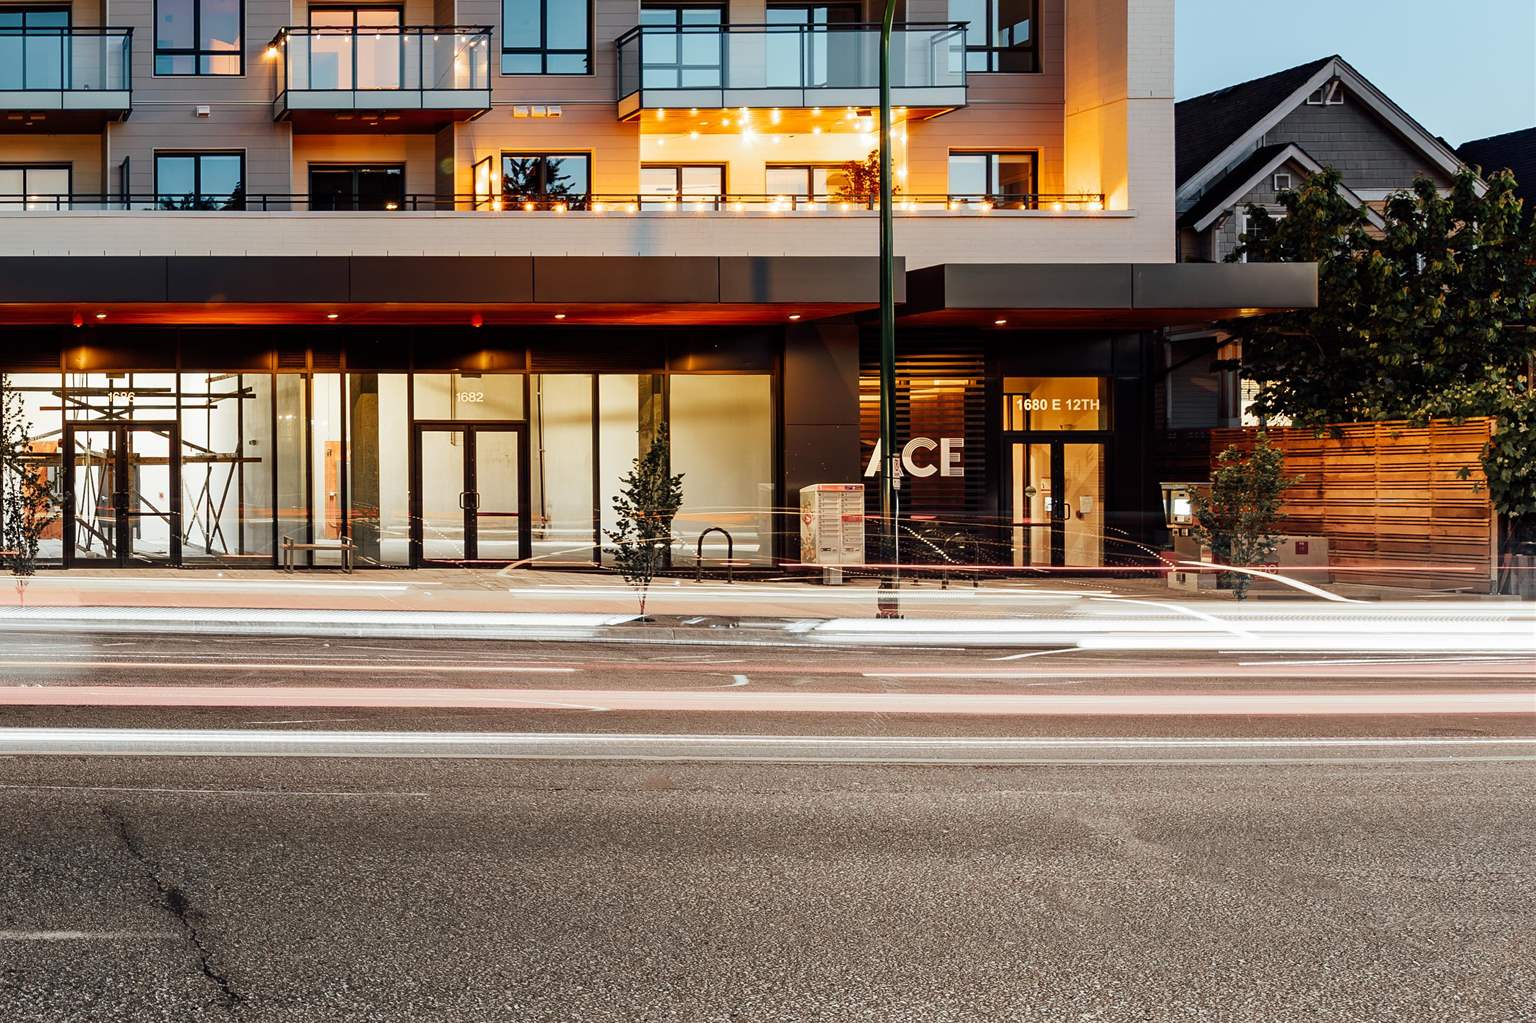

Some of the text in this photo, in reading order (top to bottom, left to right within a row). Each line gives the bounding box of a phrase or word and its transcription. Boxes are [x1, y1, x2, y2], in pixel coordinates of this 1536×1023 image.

[456, 392, 484, 402] 1682
[1016, 399, 1100, 410] 1680 E 12TH
